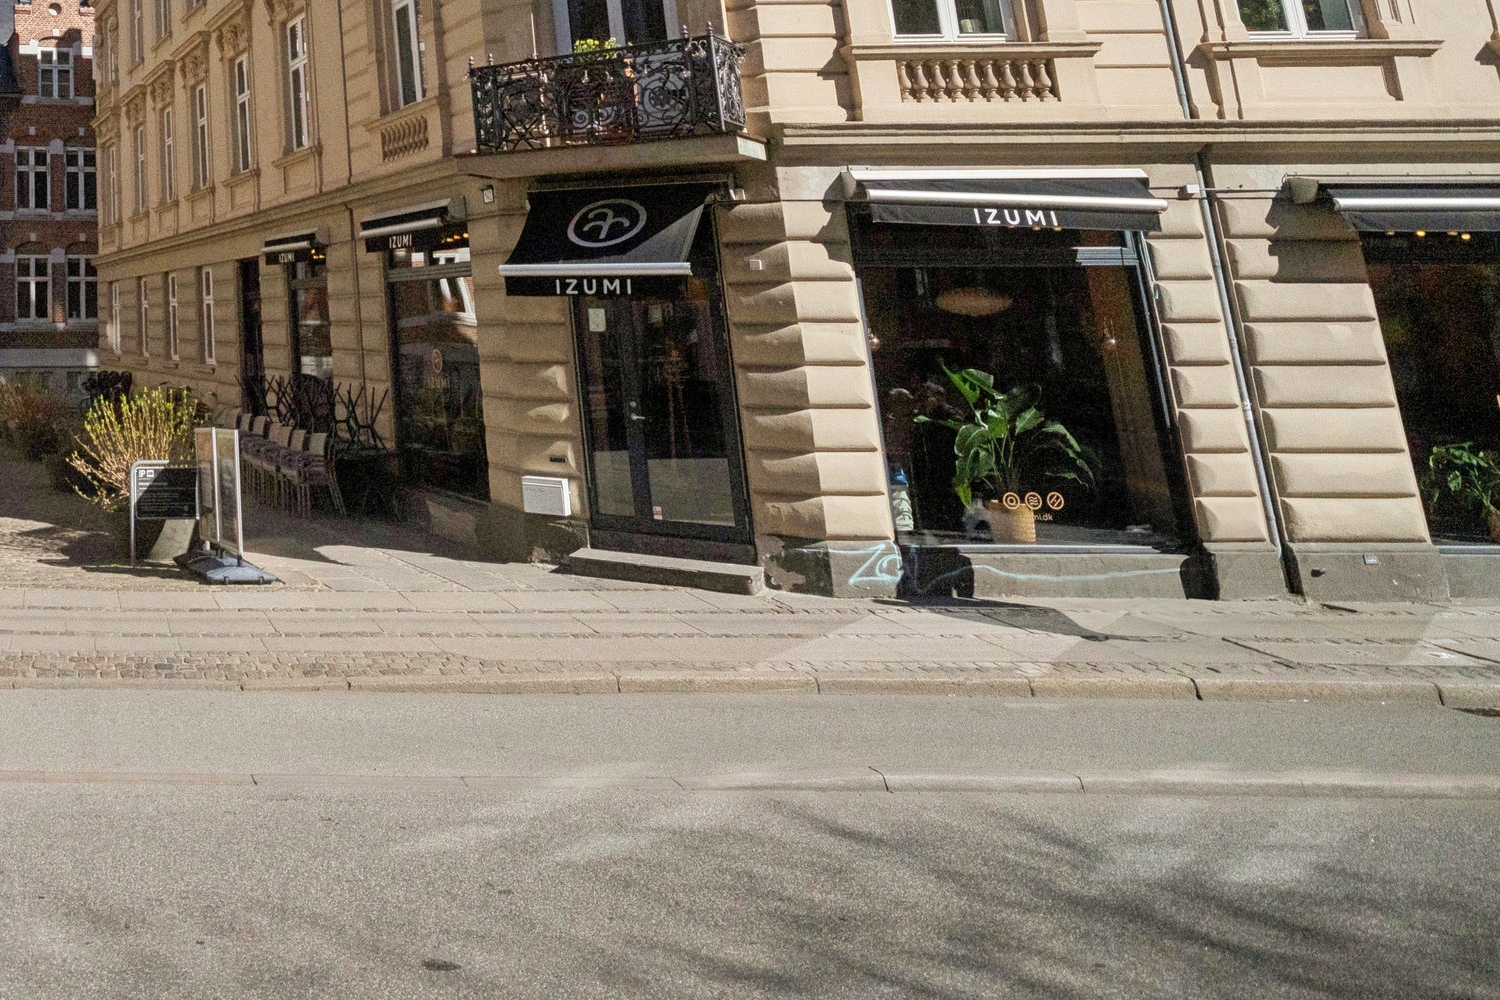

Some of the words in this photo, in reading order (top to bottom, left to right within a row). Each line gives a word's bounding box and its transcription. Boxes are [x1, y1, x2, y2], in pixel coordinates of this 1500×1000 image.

[973, 208, 1058, 226] IZUMI
[389, 234, 412, 249] IZUMI
[278, 252, 295, 263] IZUMI
[555, 278, 631, 295] IZUMI
